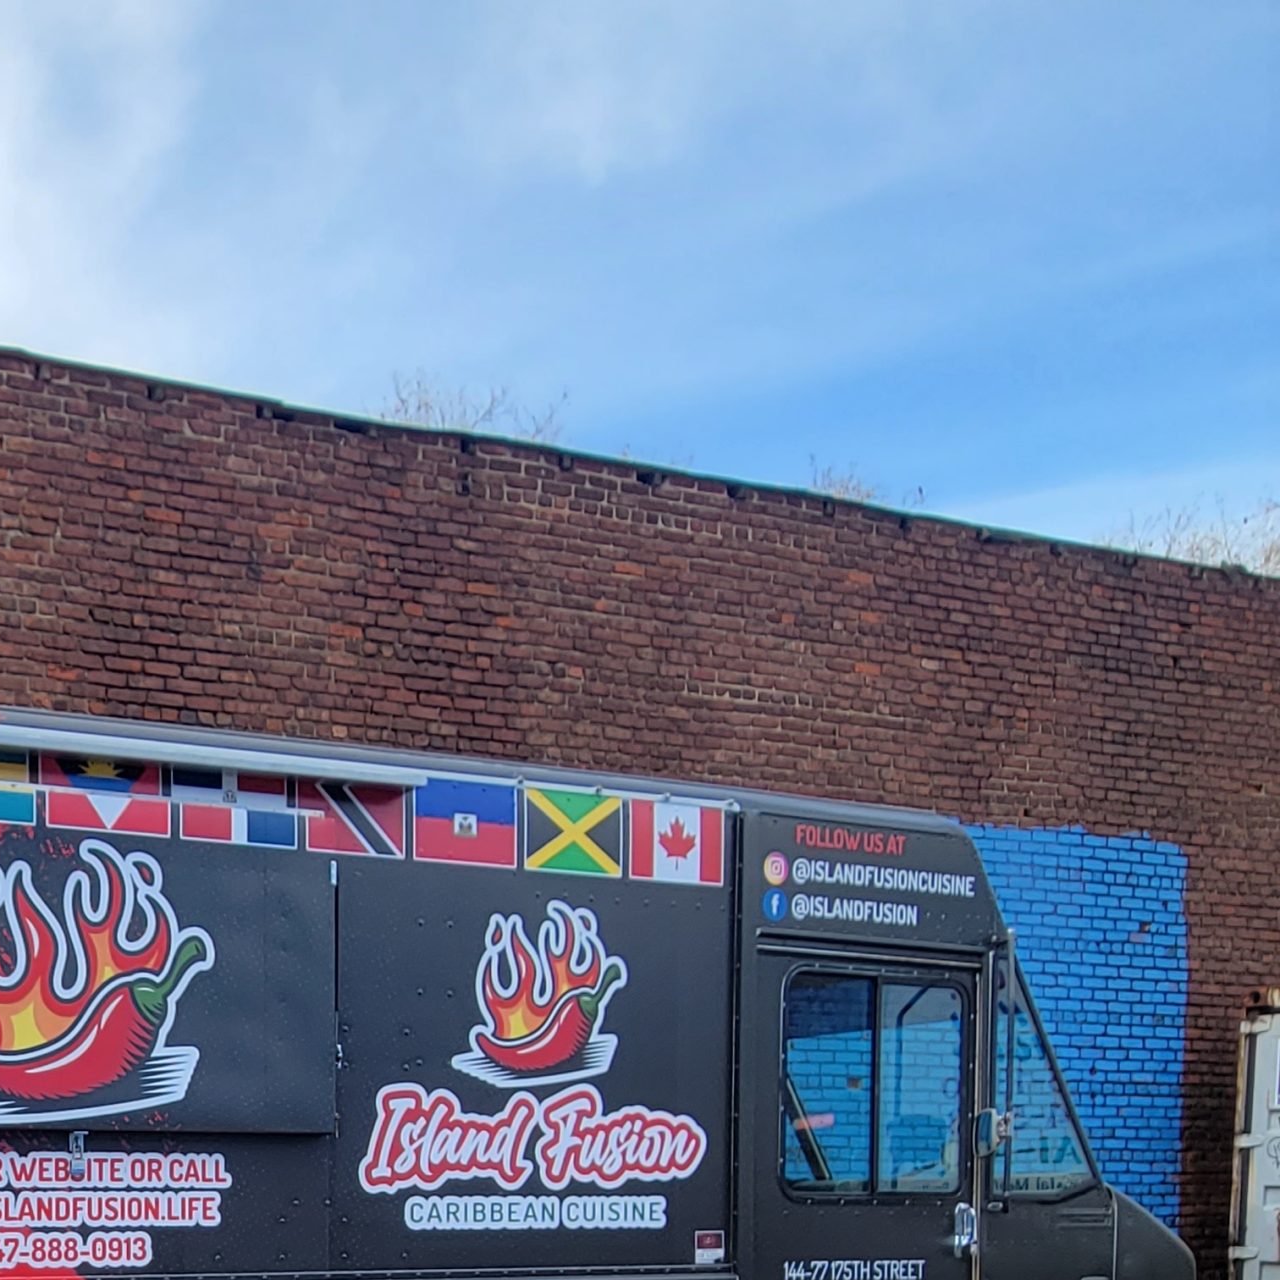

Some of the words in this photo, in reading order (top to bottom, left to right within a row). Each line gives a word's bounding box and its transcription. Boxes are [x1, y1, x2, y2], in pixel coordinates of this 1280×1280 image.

[795, 824, 862, 850] FOLLOW
[863, 832, 885, 853] US
[886, 835, 907, 855] AT
[792, 858, 976, 897] @ISLANDFUSIONCUISINE
[791, 893, 918, 926] @ISLANDFUSION
[366, 1093, 532, 1181] Island
[543, 1092, 699, 1180] Fusion
[10, 1156, 121, 1182] WEBITE
[130, 1157, 163, 1182] OR
[169, 1158, 227, 1183] CALL
[409, 1201, 556, 1223] CARIBBEAN
[566, 1201, 663, 1222] CUISINE
[783, 1261, 829, 1280] 144-77
[830, 1260, 870, 1280] 175TH
[873, 1259, 925, 1280] STREET
